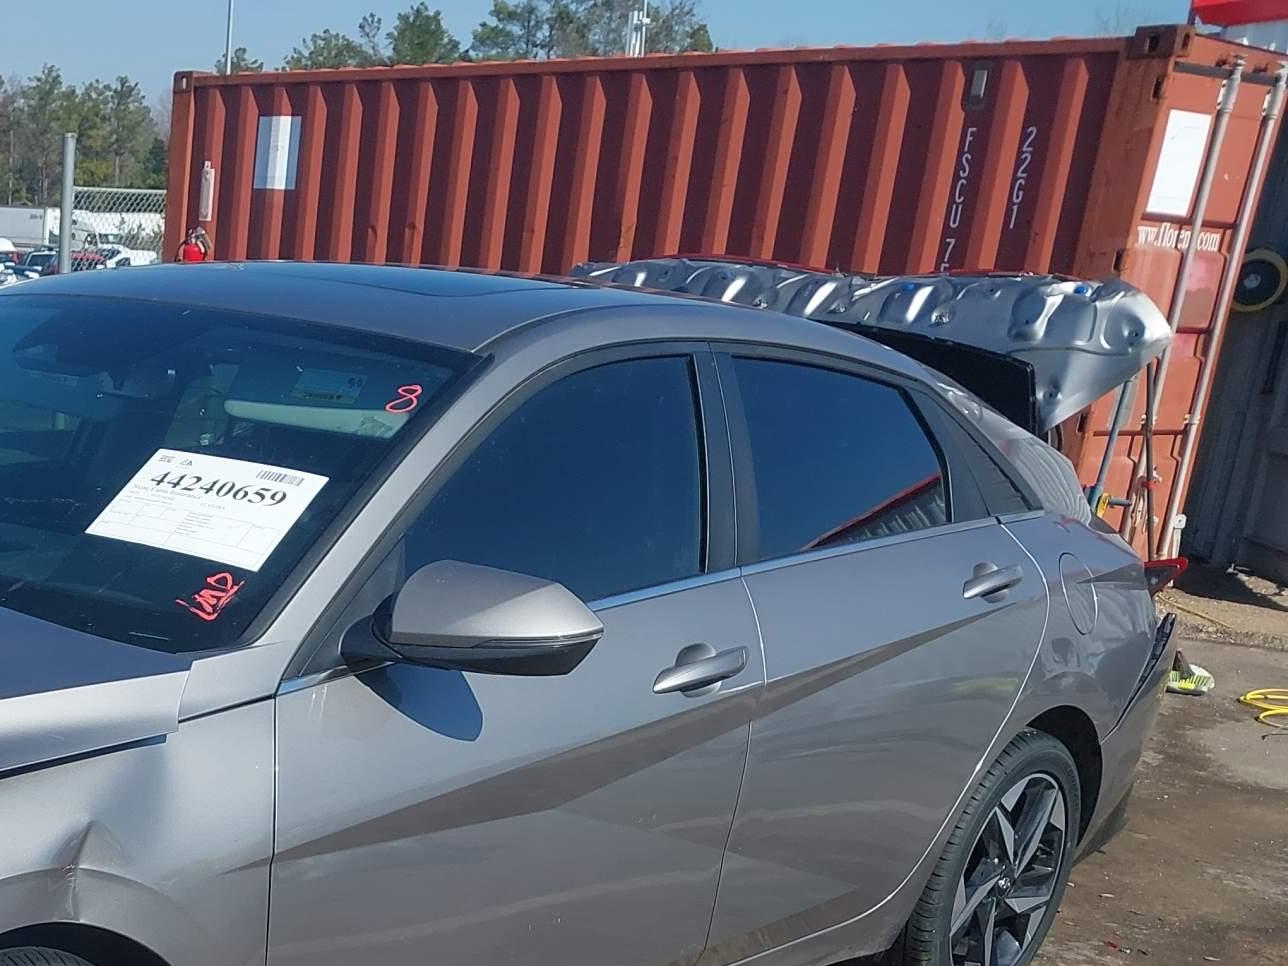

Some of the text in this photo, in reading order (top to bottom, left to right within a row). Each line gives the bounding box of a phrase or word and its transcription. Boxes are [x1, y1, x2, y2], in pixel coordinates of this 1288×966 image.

[949, 127, 977, 228] FSCU
[1009, 126, 1037, 230] 22G1
[385, 384, 423, 413] 8
[150, 471, 287, 507] 44240659
